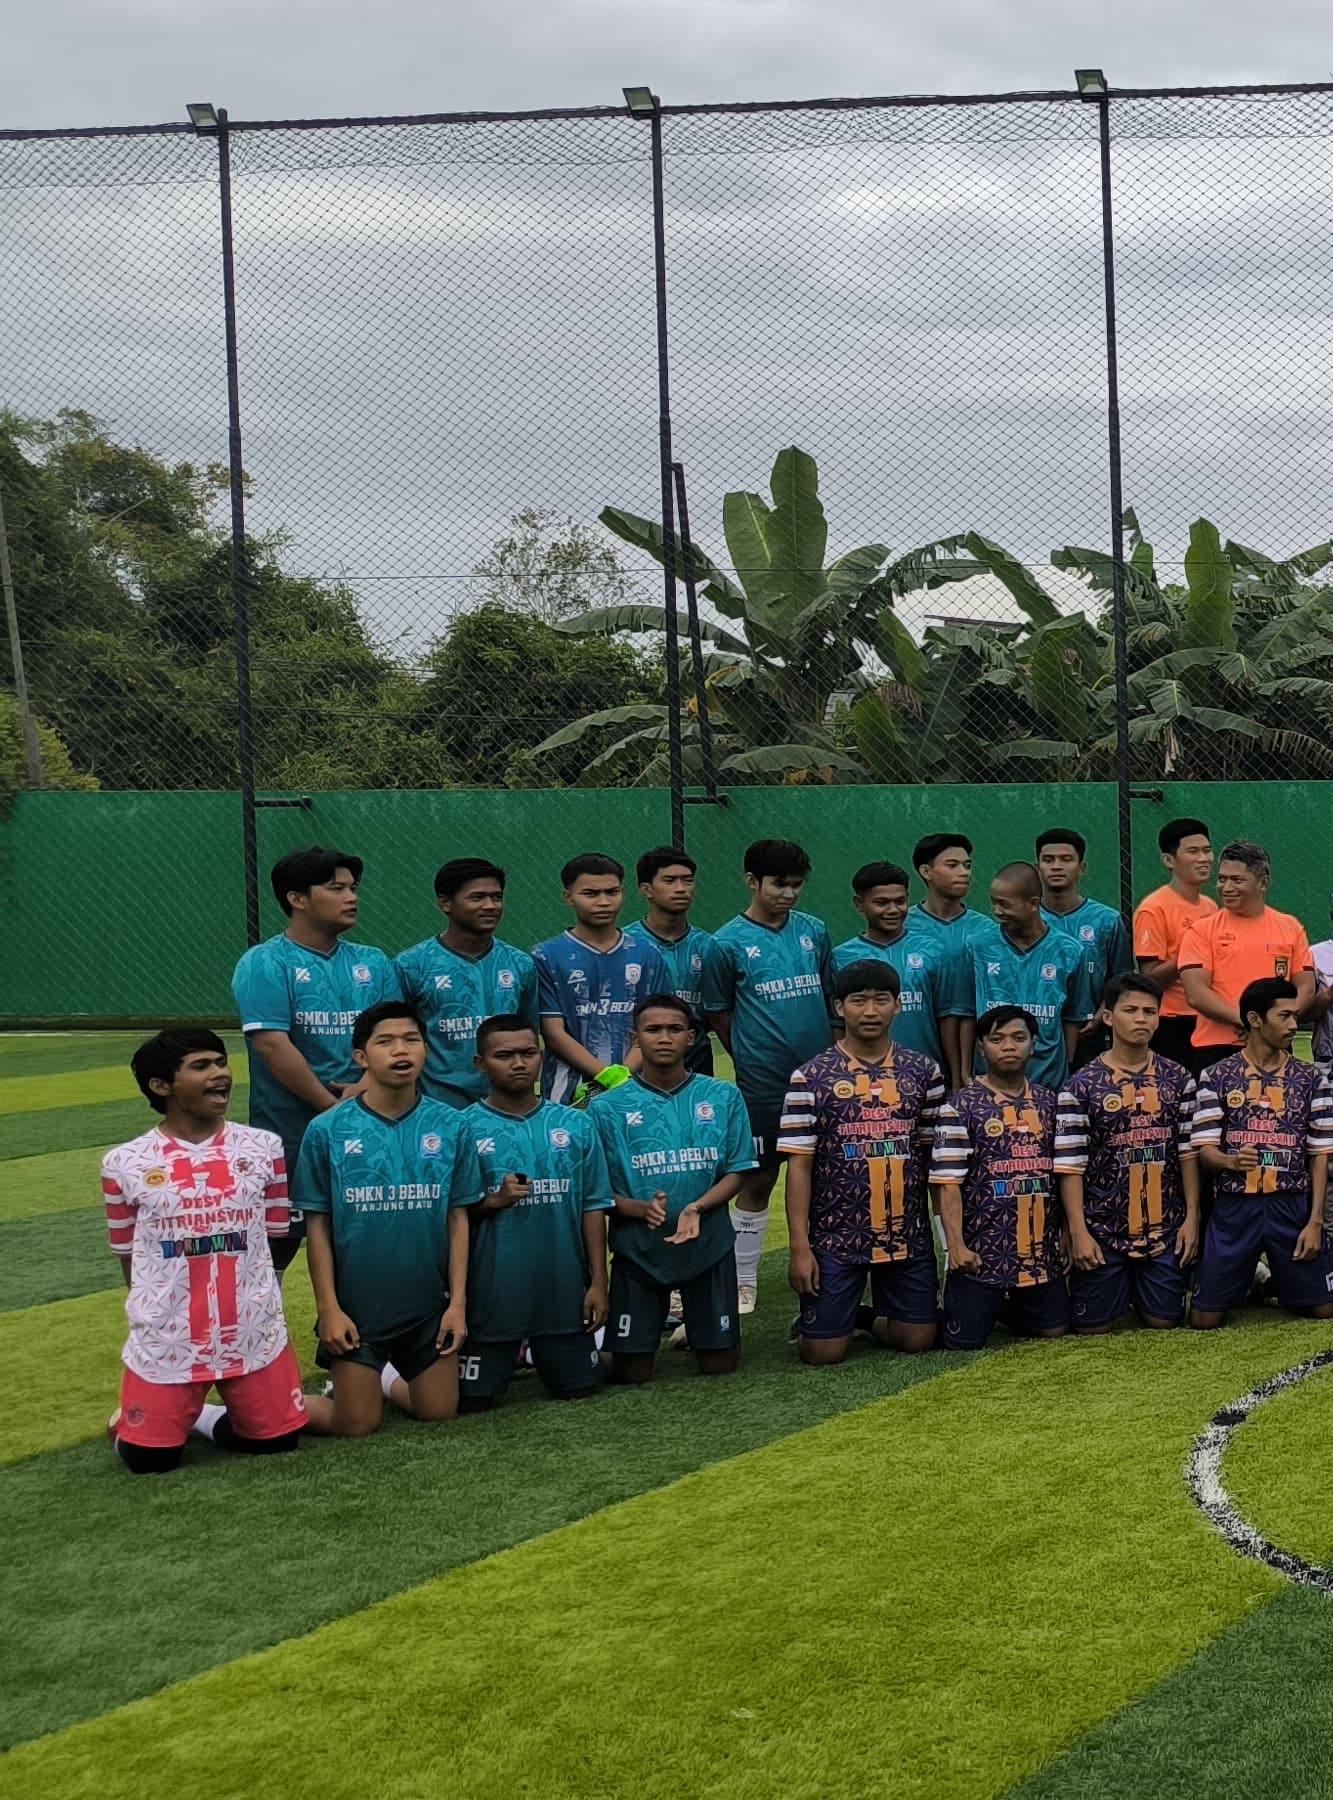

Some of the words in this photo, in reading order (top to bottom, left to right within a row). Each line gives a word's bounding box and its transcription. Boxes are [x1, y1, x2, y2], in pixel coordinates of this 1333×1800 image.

[755, 982, 786, 996] SMKN
[786, 977, 793, 990] 3
[597, 998, 610, 1016] 3
[295, 1010, 329, 1025] SMKN
[332, 1011, 339, 1026] 3
[438, 1016, 473, 1033] SMKN
[303, 1026, 346, 1035] TANJUNG
[631, 1150, 666, 1170] SMKN
[669, 1151, 677, 1166] 3
[679, 1147, 719, 1164] BERAU
[639, 1162, 687, 1178] TANJUNG
[346, 1185, 384, 1203] SMKN
[388, 1184, 395, 1201] 3
[399, 1183, 441, 1201] BERAU
[182, 1194, 222, 1210] DESY
[355, 1201, 404, 1213] TANJUNG
[617, 1314, 631, 1337] 9
